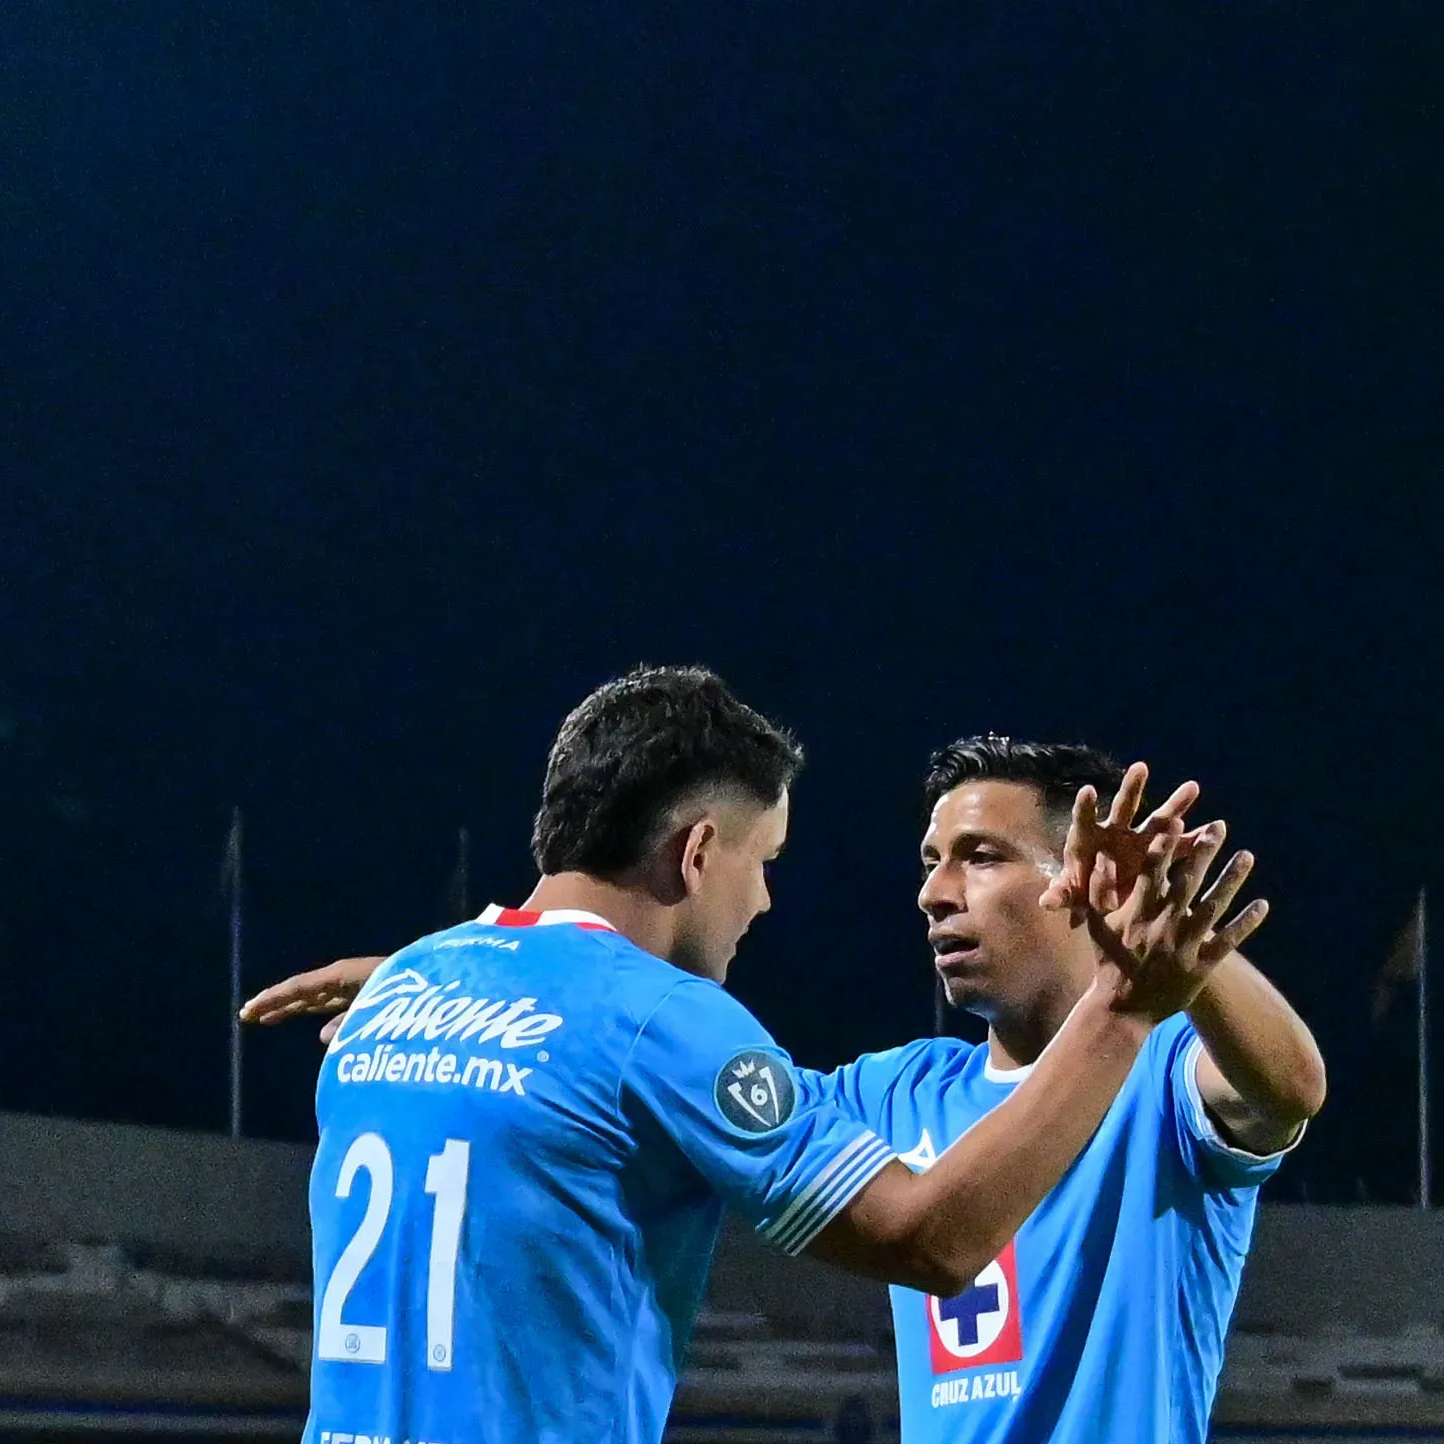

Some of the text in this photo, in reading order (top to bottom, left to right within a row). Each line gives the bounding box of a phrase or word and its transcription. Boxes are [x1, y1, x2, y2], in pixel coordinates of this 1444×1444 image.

[328, 968, 564, 1050] Caliente
[337, 1044, 533, 1096] caliente.mx
[750, 1083, 769, 1106] 6
[318, 1131, 470, 1372] 21
[931, 1371, 1022, 1409] CRUZ AZUL
